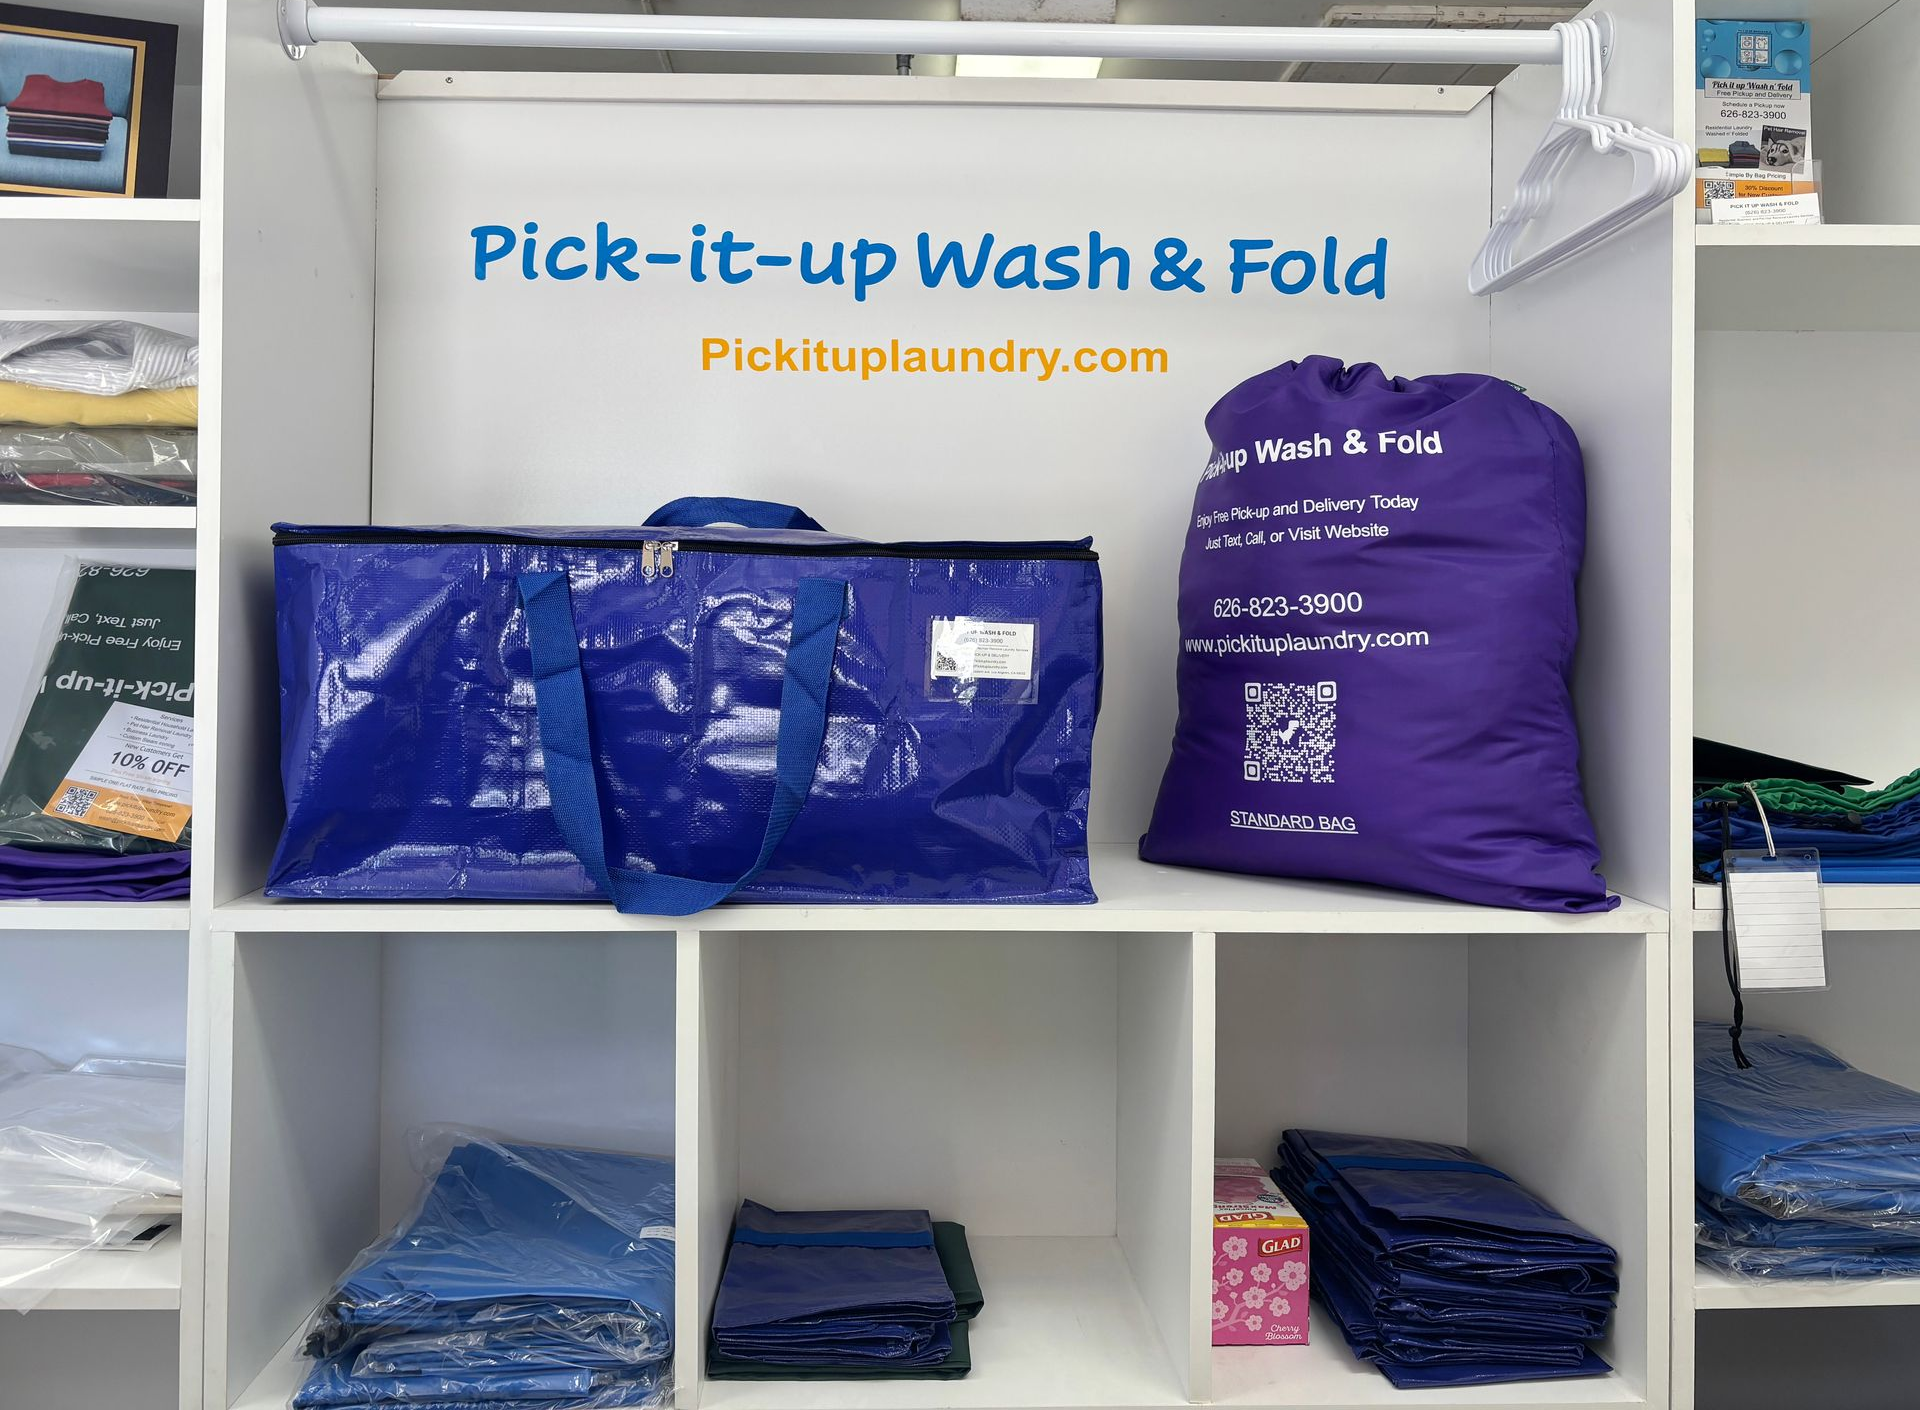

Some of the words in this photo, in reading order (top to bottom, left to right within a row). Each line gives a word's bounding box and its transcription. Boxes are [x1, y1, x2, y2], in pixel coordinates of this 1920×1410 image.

[1712, 81, 1728, 90] Pick
[1729, 81, 1734, 90] it
[1735, 83, 1745, 91] up
[1746, 82, 1769, 91] Wash
[1776, 83, 1793, 91] Fold
[1732, 90, 1753, 98] Pickup
[1720, 109, 1786, 119] 626-823-3900
[471, 222, 897, 303] Pick-it-up
[917, 231, 1131, 291] Wash
[1150, 238, 1206, 294] &
[1230, 236, 1389, 300] Fold
[701, 338, 1169, 382] Pickituplaundry.com
[1254, 432, 1332, 464] Wash
[1342, 429, 1369, 455] &
[1378, 429, 1443, 456] Fold
[1196, 515, 1212, 529] Enjoy
[1213, 510, 1230, 524] Free
[1231, 506, 1270, 522] Pick-up
[1272, 500, 1299, 517] and
[1303, 498, 1366, 514] Delivery
[1370, 494, 1420, 512] Today
[1205, 533, 1222, 550] Just
[1223, 534, 1243, 548] Text,
[1246, 530, 1266, 546] Call,
[1270, 530, 1285, 543] or
[1288, 526, 1322, 542] Visit
[1324, 524, 1390, 539] Website
[1213, 592, 1363, 618] 626-823-3900
[95, 614, 126, 628] Text,
[131, 617, 161, 629] Just
[106, 636, 139, 649] Free
[142, 636, 182, 651] Enjoy
[1185, 629, 1430, 657] www.pickituplaundry.com
[55, 670, 195, 702] Pick-it-up
[160, 714, 184, 723] Services
[148, 732, 169, 741] Laundry
[172, 730, 192, 739] Laundry
[140, 746, 171, 757] Customers
[111, 751, 149, 770] 10%
[151, 760, 190, 778] OFF
[1230, 810, 1315, 830] STANDARD
[1318, 815, 1357, 832] BAG
[1220, 1212, 1268, 1222] GLAD
[1262, 1237, 1301, 1254] GLAD
[1270, 1324, 1300, 1333] Cherry
[1265, 1332, 1302, 1341] Blossom
